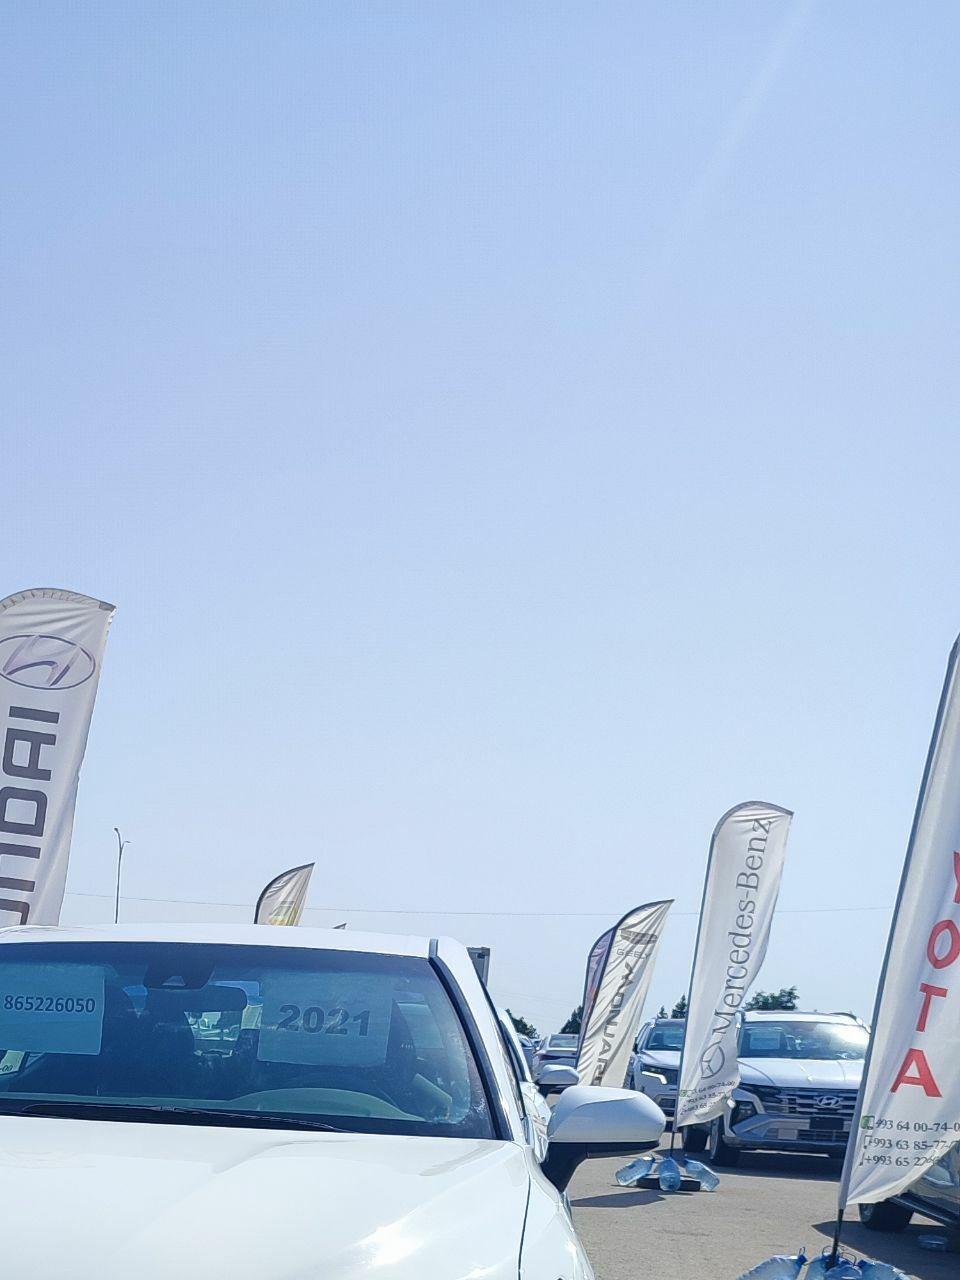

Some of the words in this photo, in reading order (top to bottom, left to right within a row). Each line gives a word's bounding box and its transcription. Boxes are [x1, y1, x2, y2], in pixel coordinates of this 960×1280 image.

[712, 818, 773, 1038] Mercedes-Benz
[617, 949, 652, 960] GEELY
[3, 995, 96, 1013] 865226050
[276, 1004, 370, 1036] 2021
[896, 1120, 910, 1131] 64
[895, 1139, 909, 1150] 63
[865, 1155, 892, 1166] +993
[895, 1157, 910, 1167] 65
